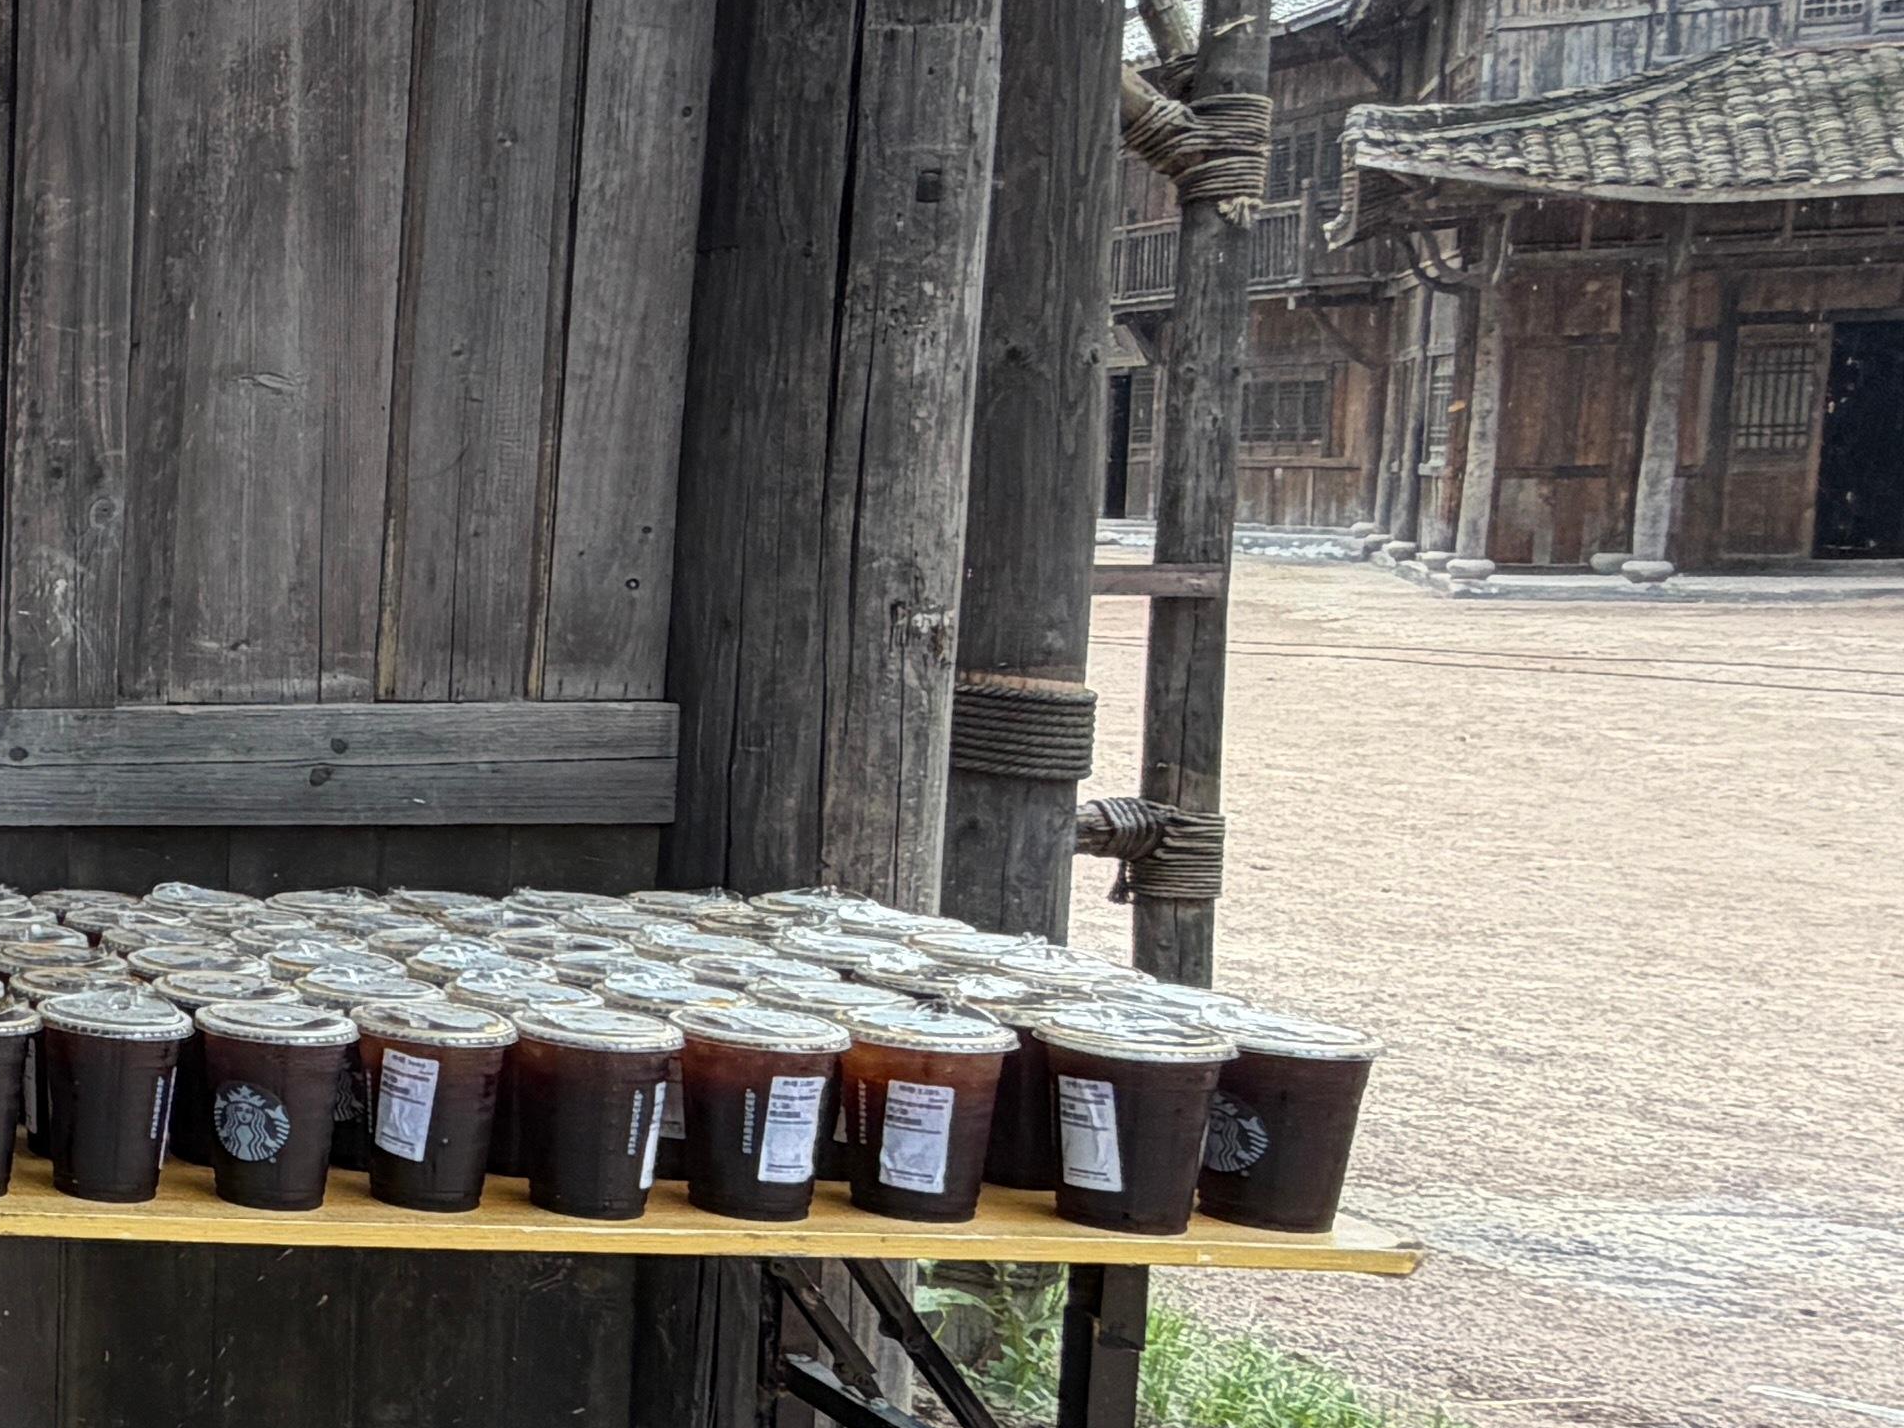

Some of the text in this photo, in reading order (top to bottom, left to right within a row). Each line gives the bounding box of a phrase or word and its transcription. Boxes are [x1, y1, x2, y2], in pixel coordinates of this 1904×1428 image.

[627, 1089, 644, 1156] STARBUCKS
[742, 1088, 756, 1154] STARBUCKS
[857, 1079, 868, 1145] STARBUCKS
